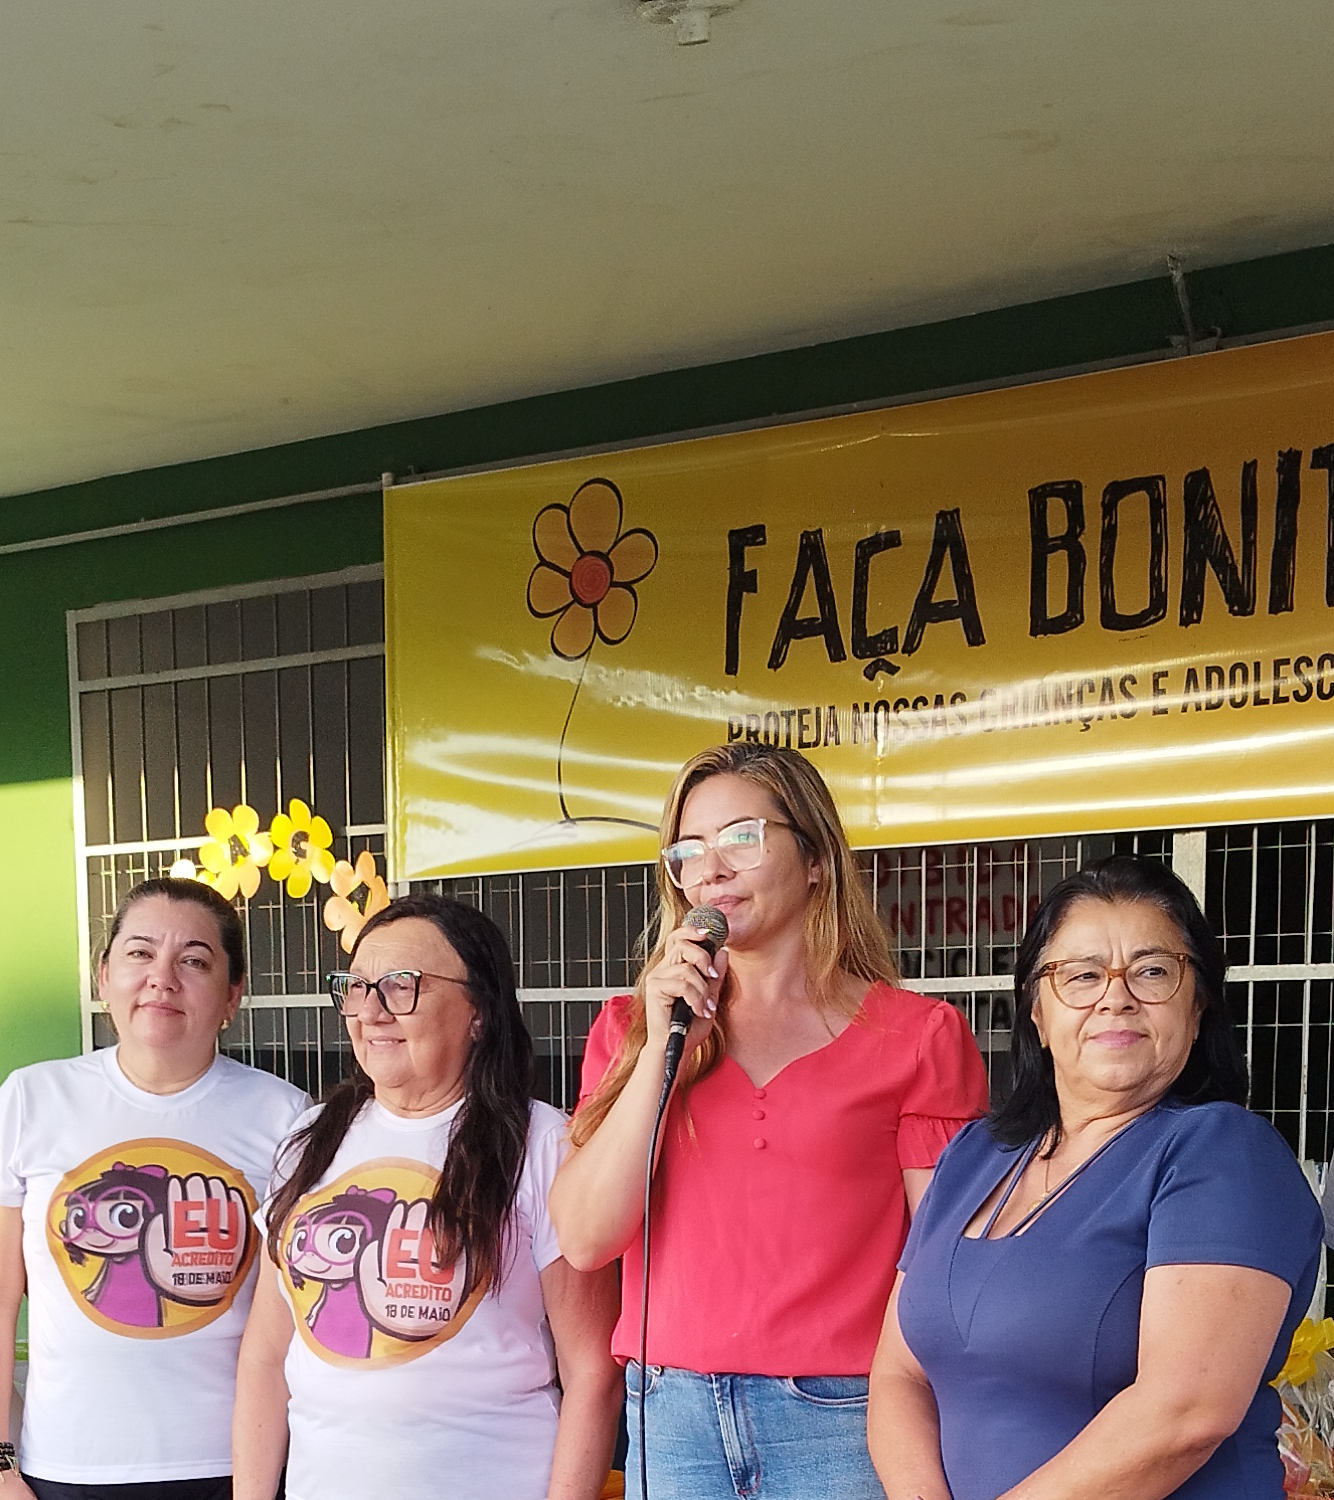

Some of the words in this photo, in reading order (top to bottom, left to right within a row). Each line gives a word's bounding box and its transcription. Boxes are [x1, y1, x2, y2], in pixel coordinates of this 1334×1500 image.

[725, 506, 986, 681] FAÇA
[727, 705, 841, 749] PROTEJA
[852, 691, 969, 745] NOSSAS
[979, 673, 1138, 733] CRIANÇAS
[1152, 670, 1169, 716] E
[172, 1198, 238, 1251] EU
[172, 1273, 184, 1286] 18
[188, 1272, 204, 1285] DE
[386, 1228, 455, 1285] EU
[385, 1304, 397, 1318] 18
[401, 1305, 415, 1318] DE
